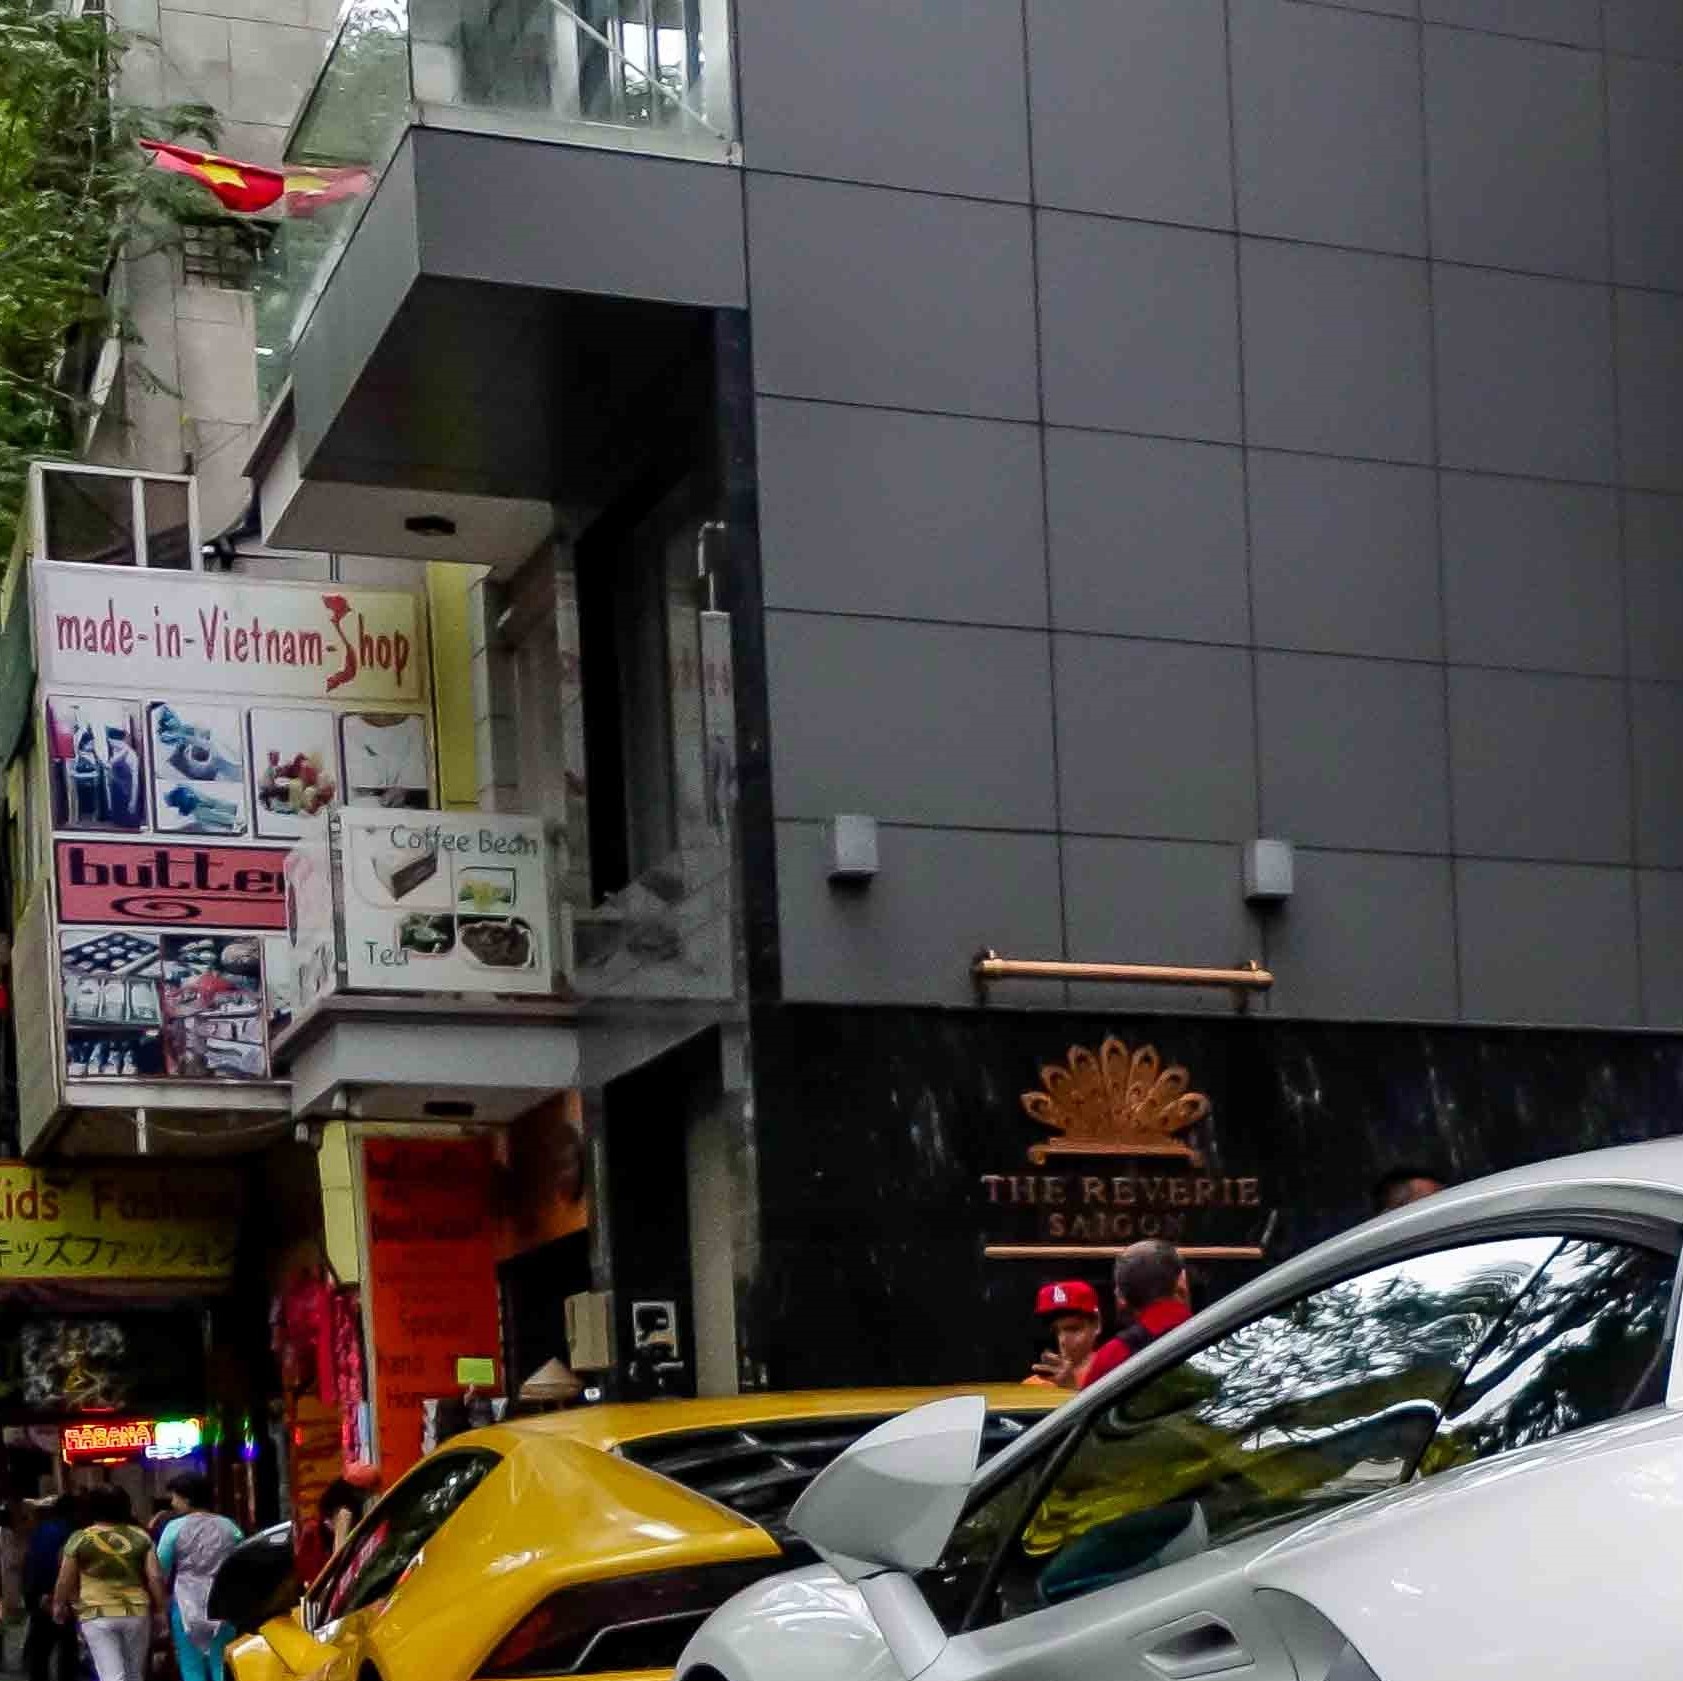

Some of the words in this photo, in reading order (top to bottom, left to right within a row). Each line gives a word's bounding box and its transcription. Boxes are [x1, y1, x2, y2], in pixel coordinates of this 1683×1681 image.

[390, 824, 470, 855] Coffee
[0, 1170, 60, 1222] ids
[980, 1174, 1068, 1206] THE
[1081, 1176, 1261, 1207] REVERIE
